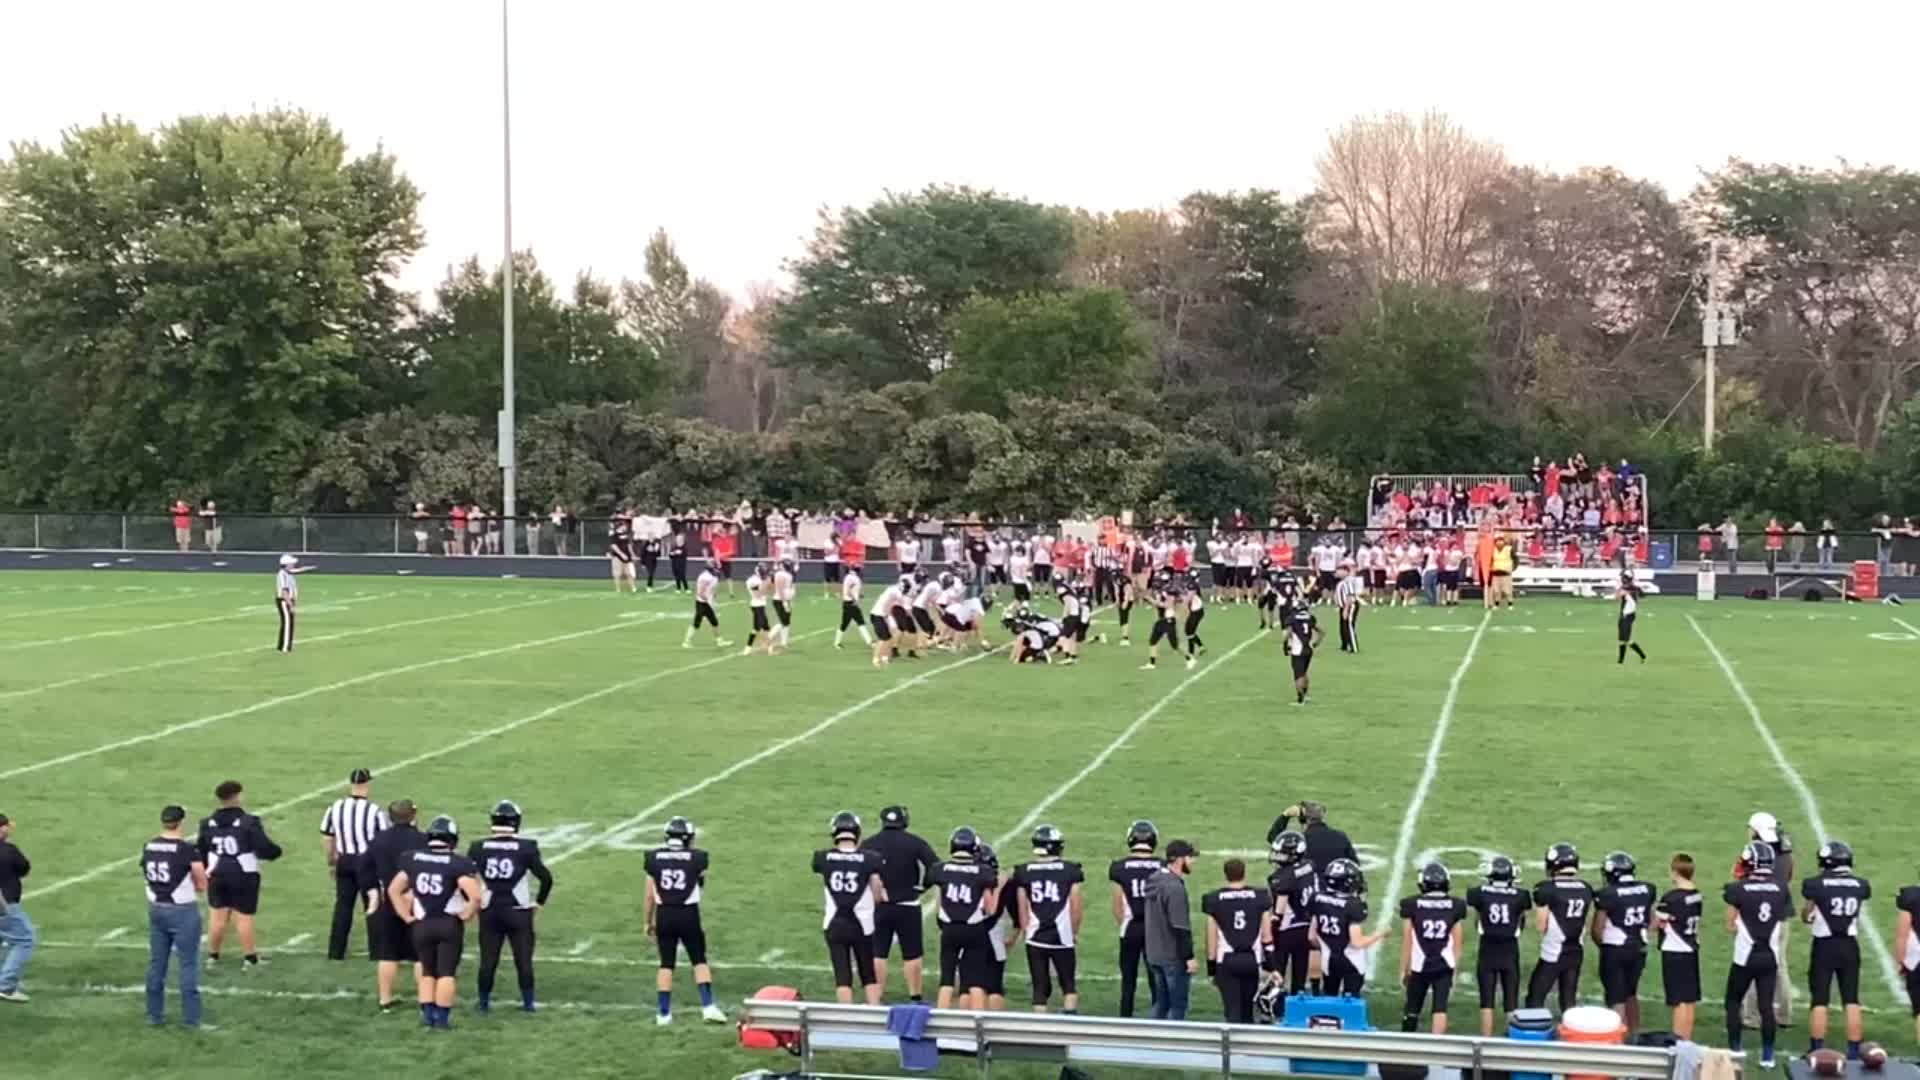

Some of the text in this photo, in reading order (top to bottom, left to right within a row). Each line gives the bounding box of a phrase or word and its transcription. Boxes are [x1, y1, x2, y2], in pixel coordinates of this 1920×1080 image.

[212, 836, 238, 855] 70
[146, 861, 170, 883] 55
[485, 858, 514, 879] 59
[661, 868, 686, 890] 52
[416, 872, 443, 895] 65
[830, 871, 858, 893] 63
[1031, 880, 1060, 902] 54
[946, 883, 972, 904] 44
[1489, 903, 1510, 924] 81
[1566, 899, 1585, 918] 12
[1757, 902, 1772, 923] 8
[1831, 897, 1858, 916] 20
[1234, 909, 1247, 930] 5
[1319, 914, 1341, 935] 23
[1422, 919, 1448, 939] 22
